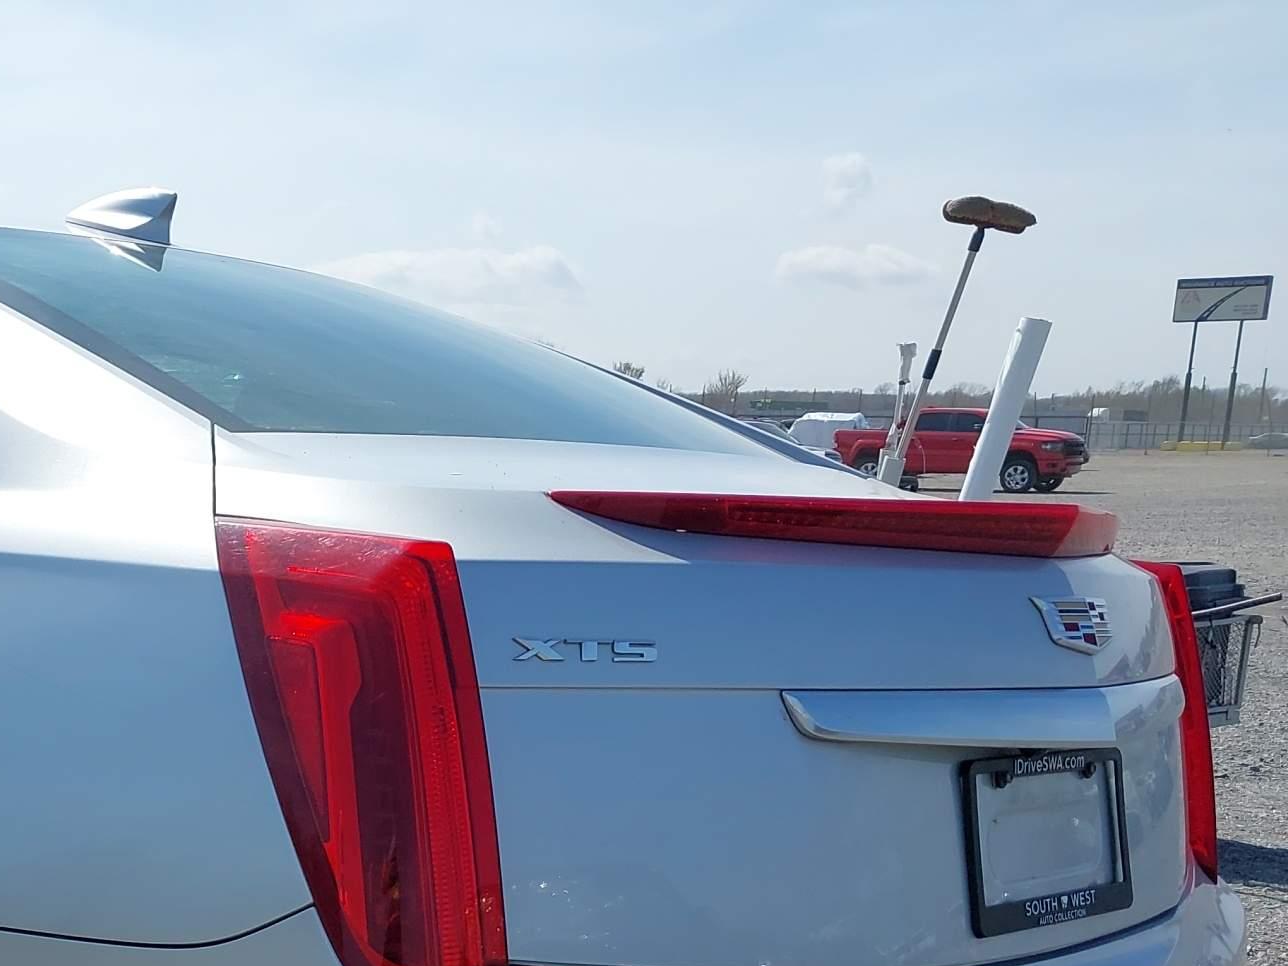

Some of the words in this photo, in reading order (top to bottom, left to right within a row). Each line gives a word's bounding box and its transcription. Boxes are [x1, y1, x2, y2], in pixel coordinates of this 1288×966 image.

[511, 637, 658, 663] XTS
[1025, 897, 1058, 916] SOUTH
[1071, 889, 1096, 907] WEST
[1039, 915, 1054, 925] AUTO
[1054, 908, 1086, 922] COLLECTION
